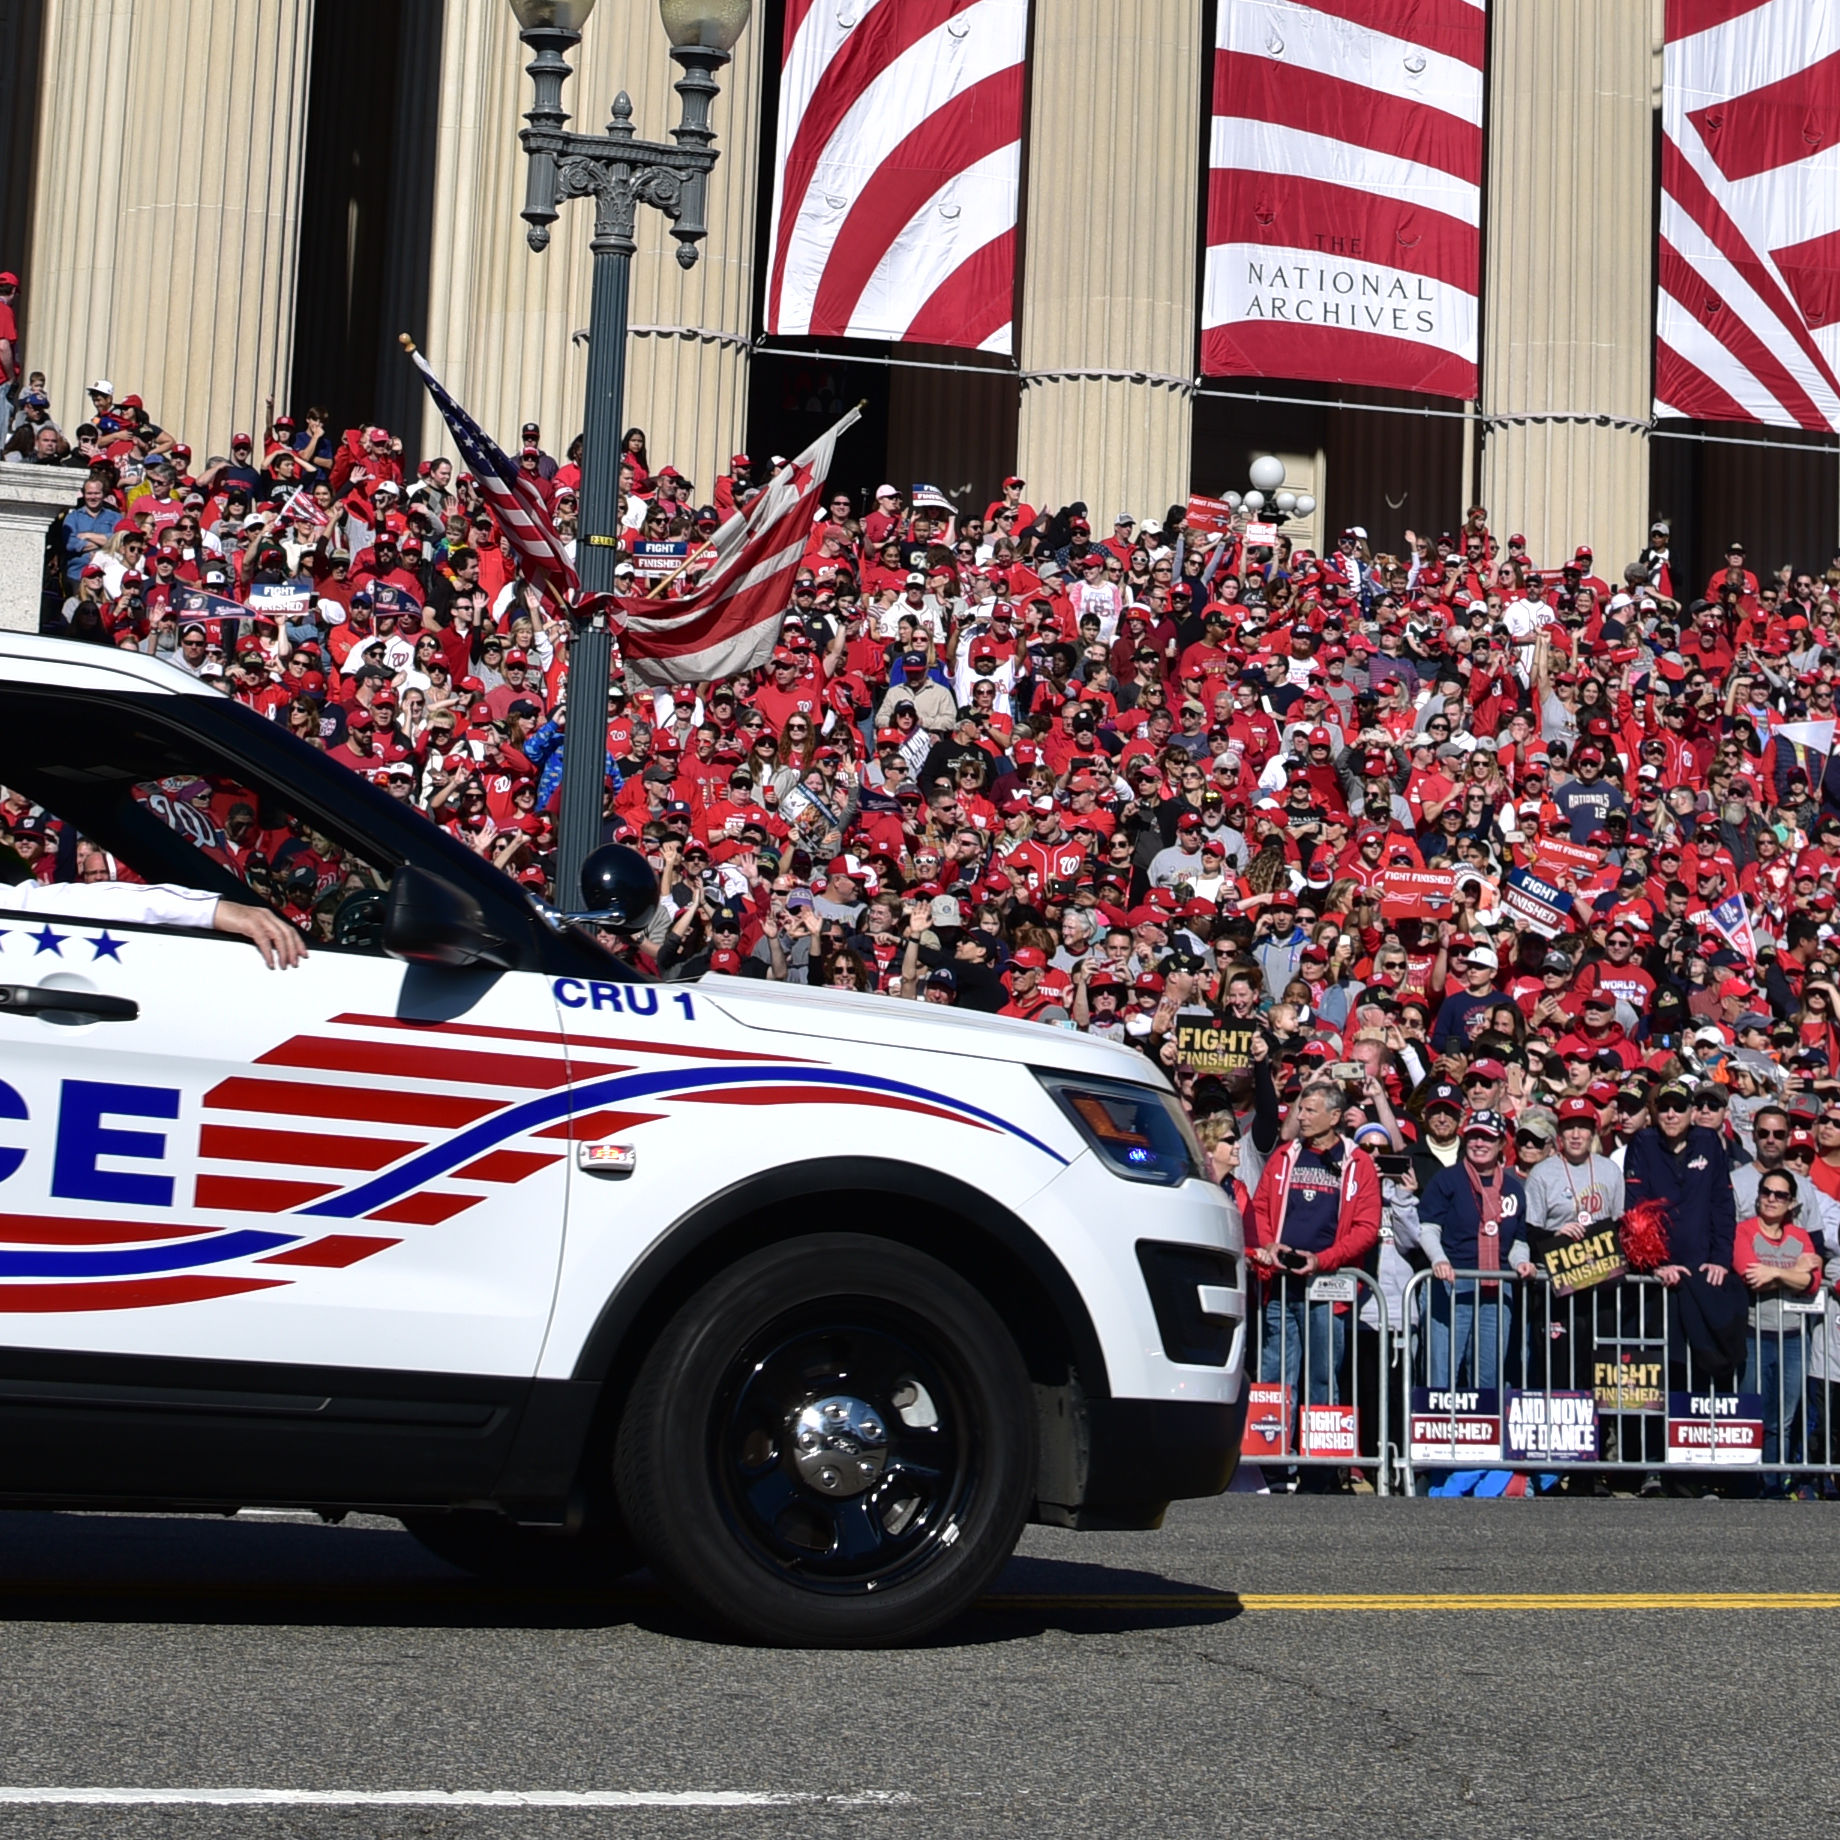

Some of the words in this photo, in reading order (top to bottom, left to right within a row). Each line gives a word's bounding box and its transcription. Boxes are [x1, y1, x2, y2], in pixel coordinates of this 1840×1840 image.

[1315, 234, 1362, 254] THE
[1248, 262, 1435, 302] NATIONAL
[1245, 294, 1435, 332] ARCHIVES
[646, 543, 675, 553] FIGHT
[638, 558, 682, 568] FINISHED
[264, 586, 294, 596] FIGHT
[1568, 793, 1610, 808] NATIONALS
[1594, 806, 1606, 819] 12
[1540, 838, 1562, 852] FIGHT
[1384, 870, 1411, 882] FIGHT
[1521, 875, 1558, 902] FIGHT
[1506, 890, 1558, 926] FINISHED
[1600, 980, 1636, 990] WORLD
[554, 976, 658, 1017] CRU
[673, 992, 696, 1021] 1
[1178, 1027, 1253, 1052] FIGHT
[1544, 1230, 1616, 1275] FIGHT
[1594, 1362, 1661, 1386] FIGHT
[1428, 1392, 1480, 1410] FIGHT
[1691, 1397, 1739, 1415] FIGHT
[1508, 1398, 1545, 1424] AND
[1550, 1398, 1594, 1425] NOW
[1414, 1422, 1493, 1440] FINISHED
[1508, 1424, 1538, 1450] WE
[1539, 1424, 1595, 1450] DANCE
[1678, 1426, 1754, 1444] FINISHED
